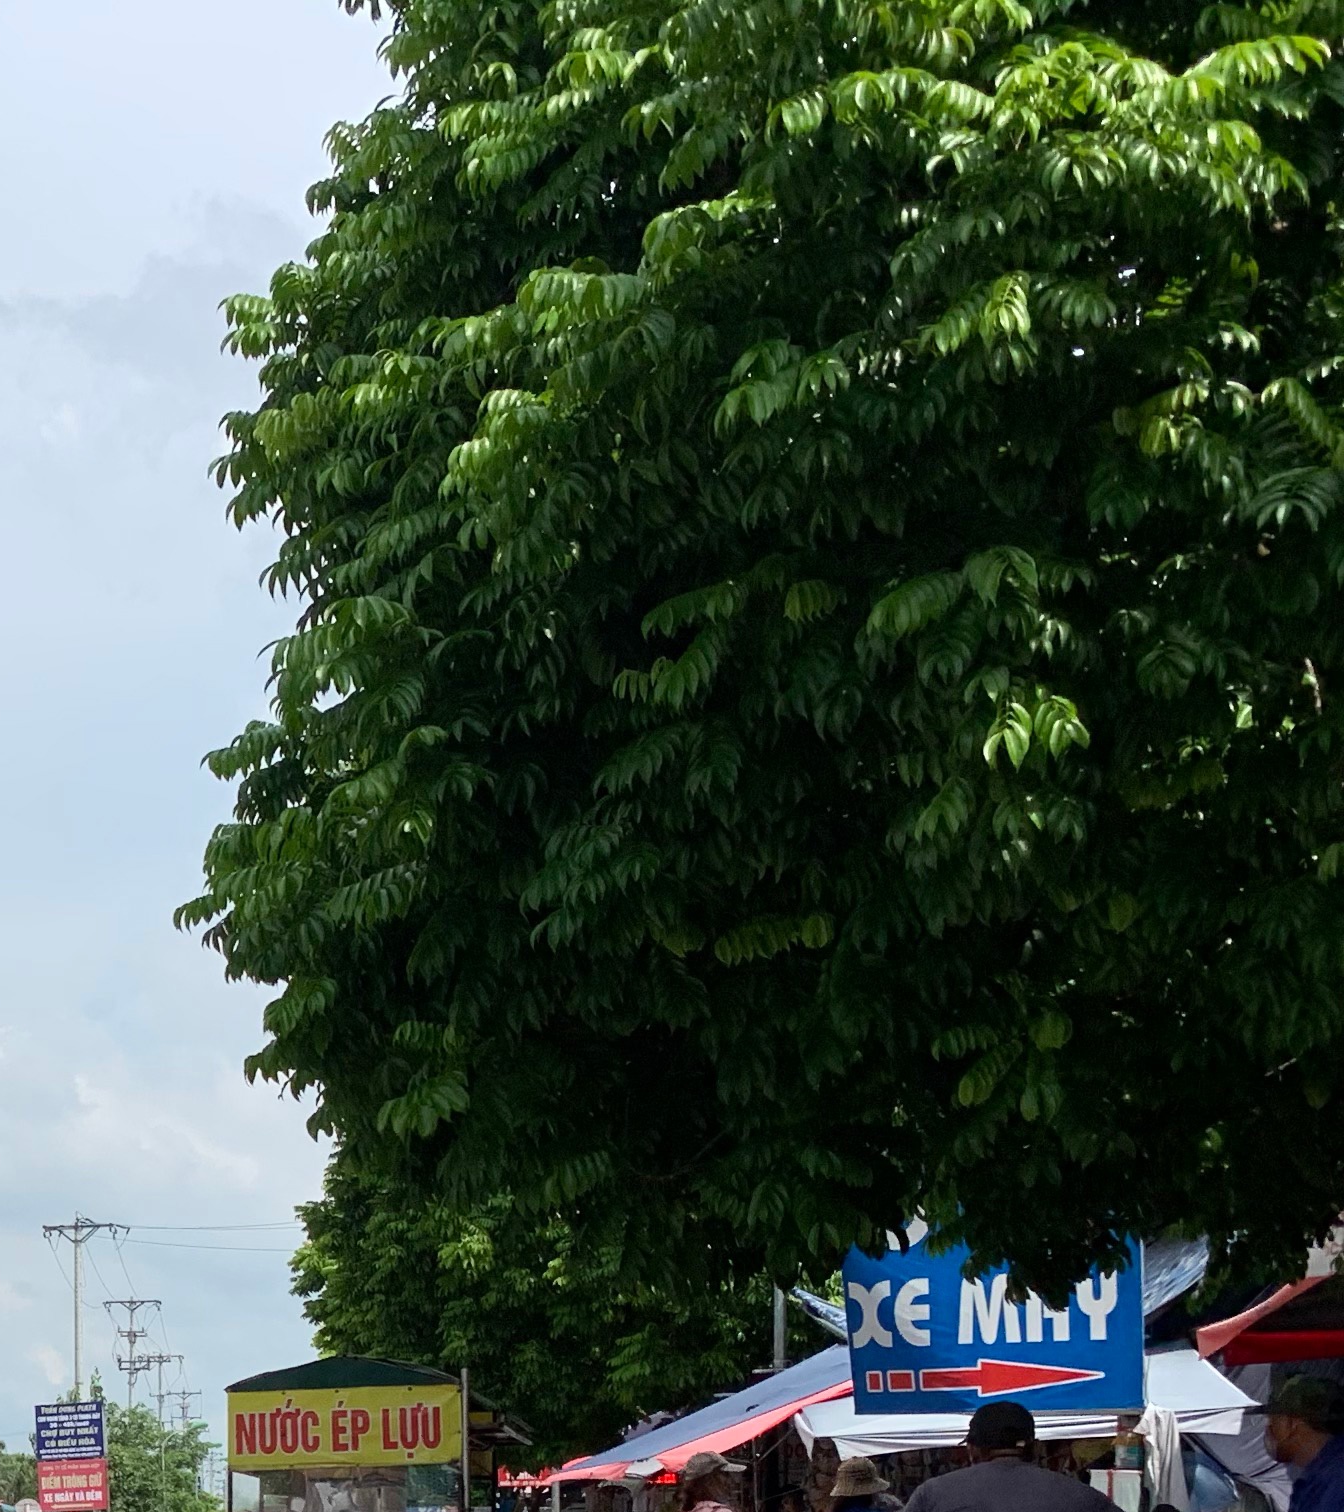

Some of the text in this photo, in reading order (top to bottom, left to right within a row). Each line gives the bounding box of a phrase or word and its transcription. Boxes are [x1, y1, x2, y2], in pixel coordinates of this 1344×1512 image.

[848, 1277, 931, 1348] XE
[234, 1399, 441, 1459] NƯỚC ÉP LỰU
[44, 1494, 53, 1503] XE
[75, 1490, 85, 1502] VÀ
